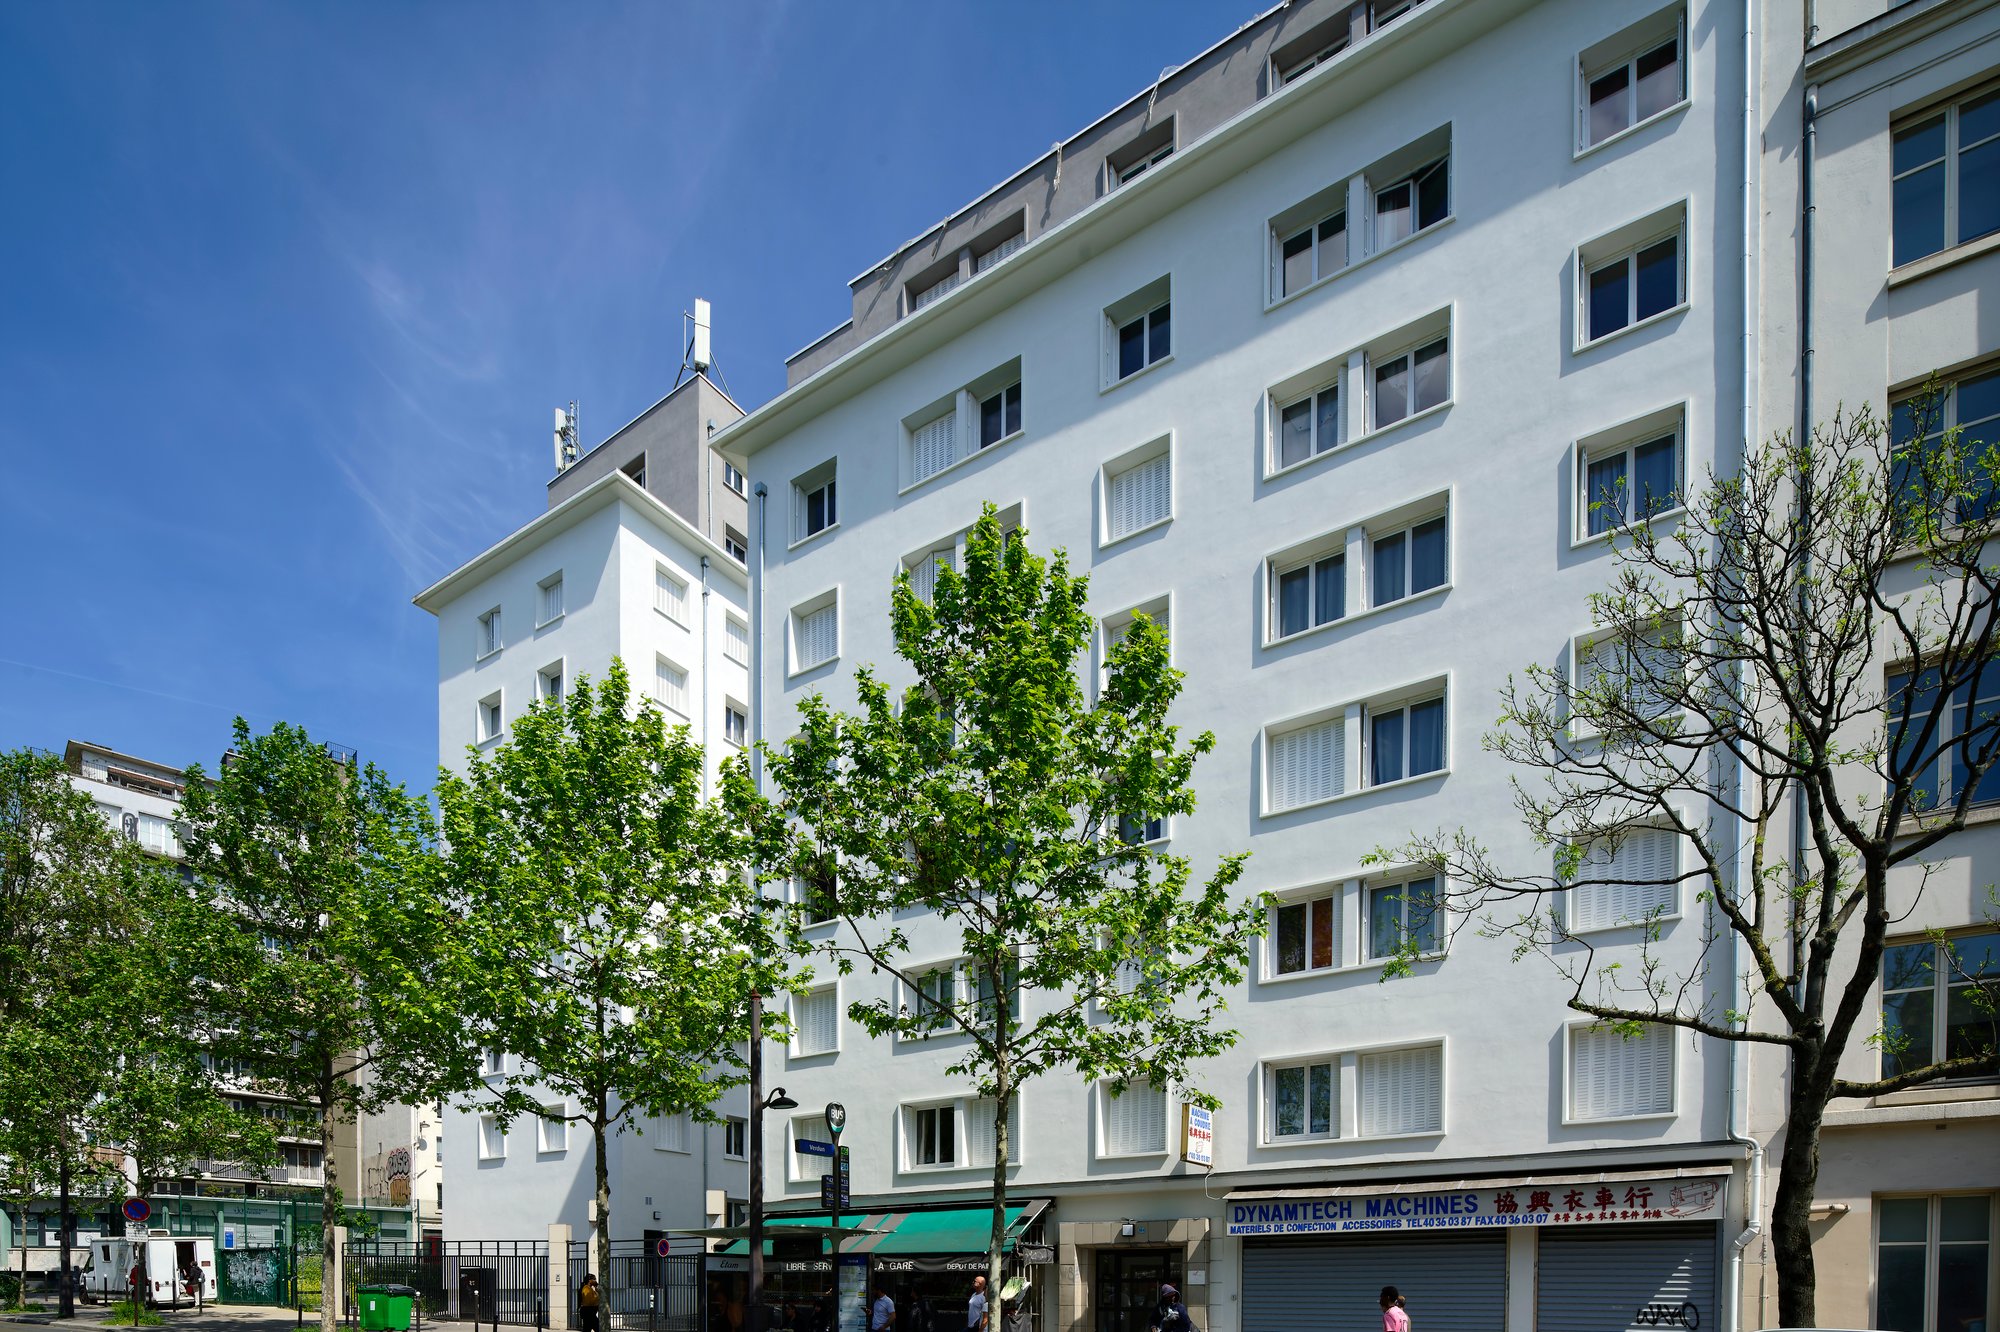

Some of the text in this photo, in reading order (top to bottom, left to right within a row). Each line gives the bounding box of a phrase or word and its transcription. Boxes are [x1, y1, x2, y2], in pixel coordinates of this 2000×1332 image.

[830, 1108, 844, 1120] BUS
[1191, 1108, 1210, 1120] MACHINE
[1194, 1118, 1210, 1130] COUDRE
[809, 1144, 826, 1152] Verdun
[1234, 1194, 1478, 1223] DYNAMTECH MACHINES
[1230, 1224, 1271, 1234] MATERIELS
[1274, 1224, 1284, 1232] DE
[1286, 1222, 1336, 1232] CONFECTION
[1342, 1220, 1402, 1230] ACCESSOIRES
[1436, 1217, 1446, 1226] 36
[1448, 1217, 1459, 1226] 03
[1461, 1216, 1472, 1226] 87
[1509, 1215, 1520, 1224] 36
[1522, 1214, 1534, 1224] 03
[1536, 1214, 1548, 1223] 07
[720, 1260, 739, 1268] Etam
[786, 1262, 806, 1270] LIBRE
[874, 1262, 884, 1270] A
[890, 1261, 914, 1270] GARE
